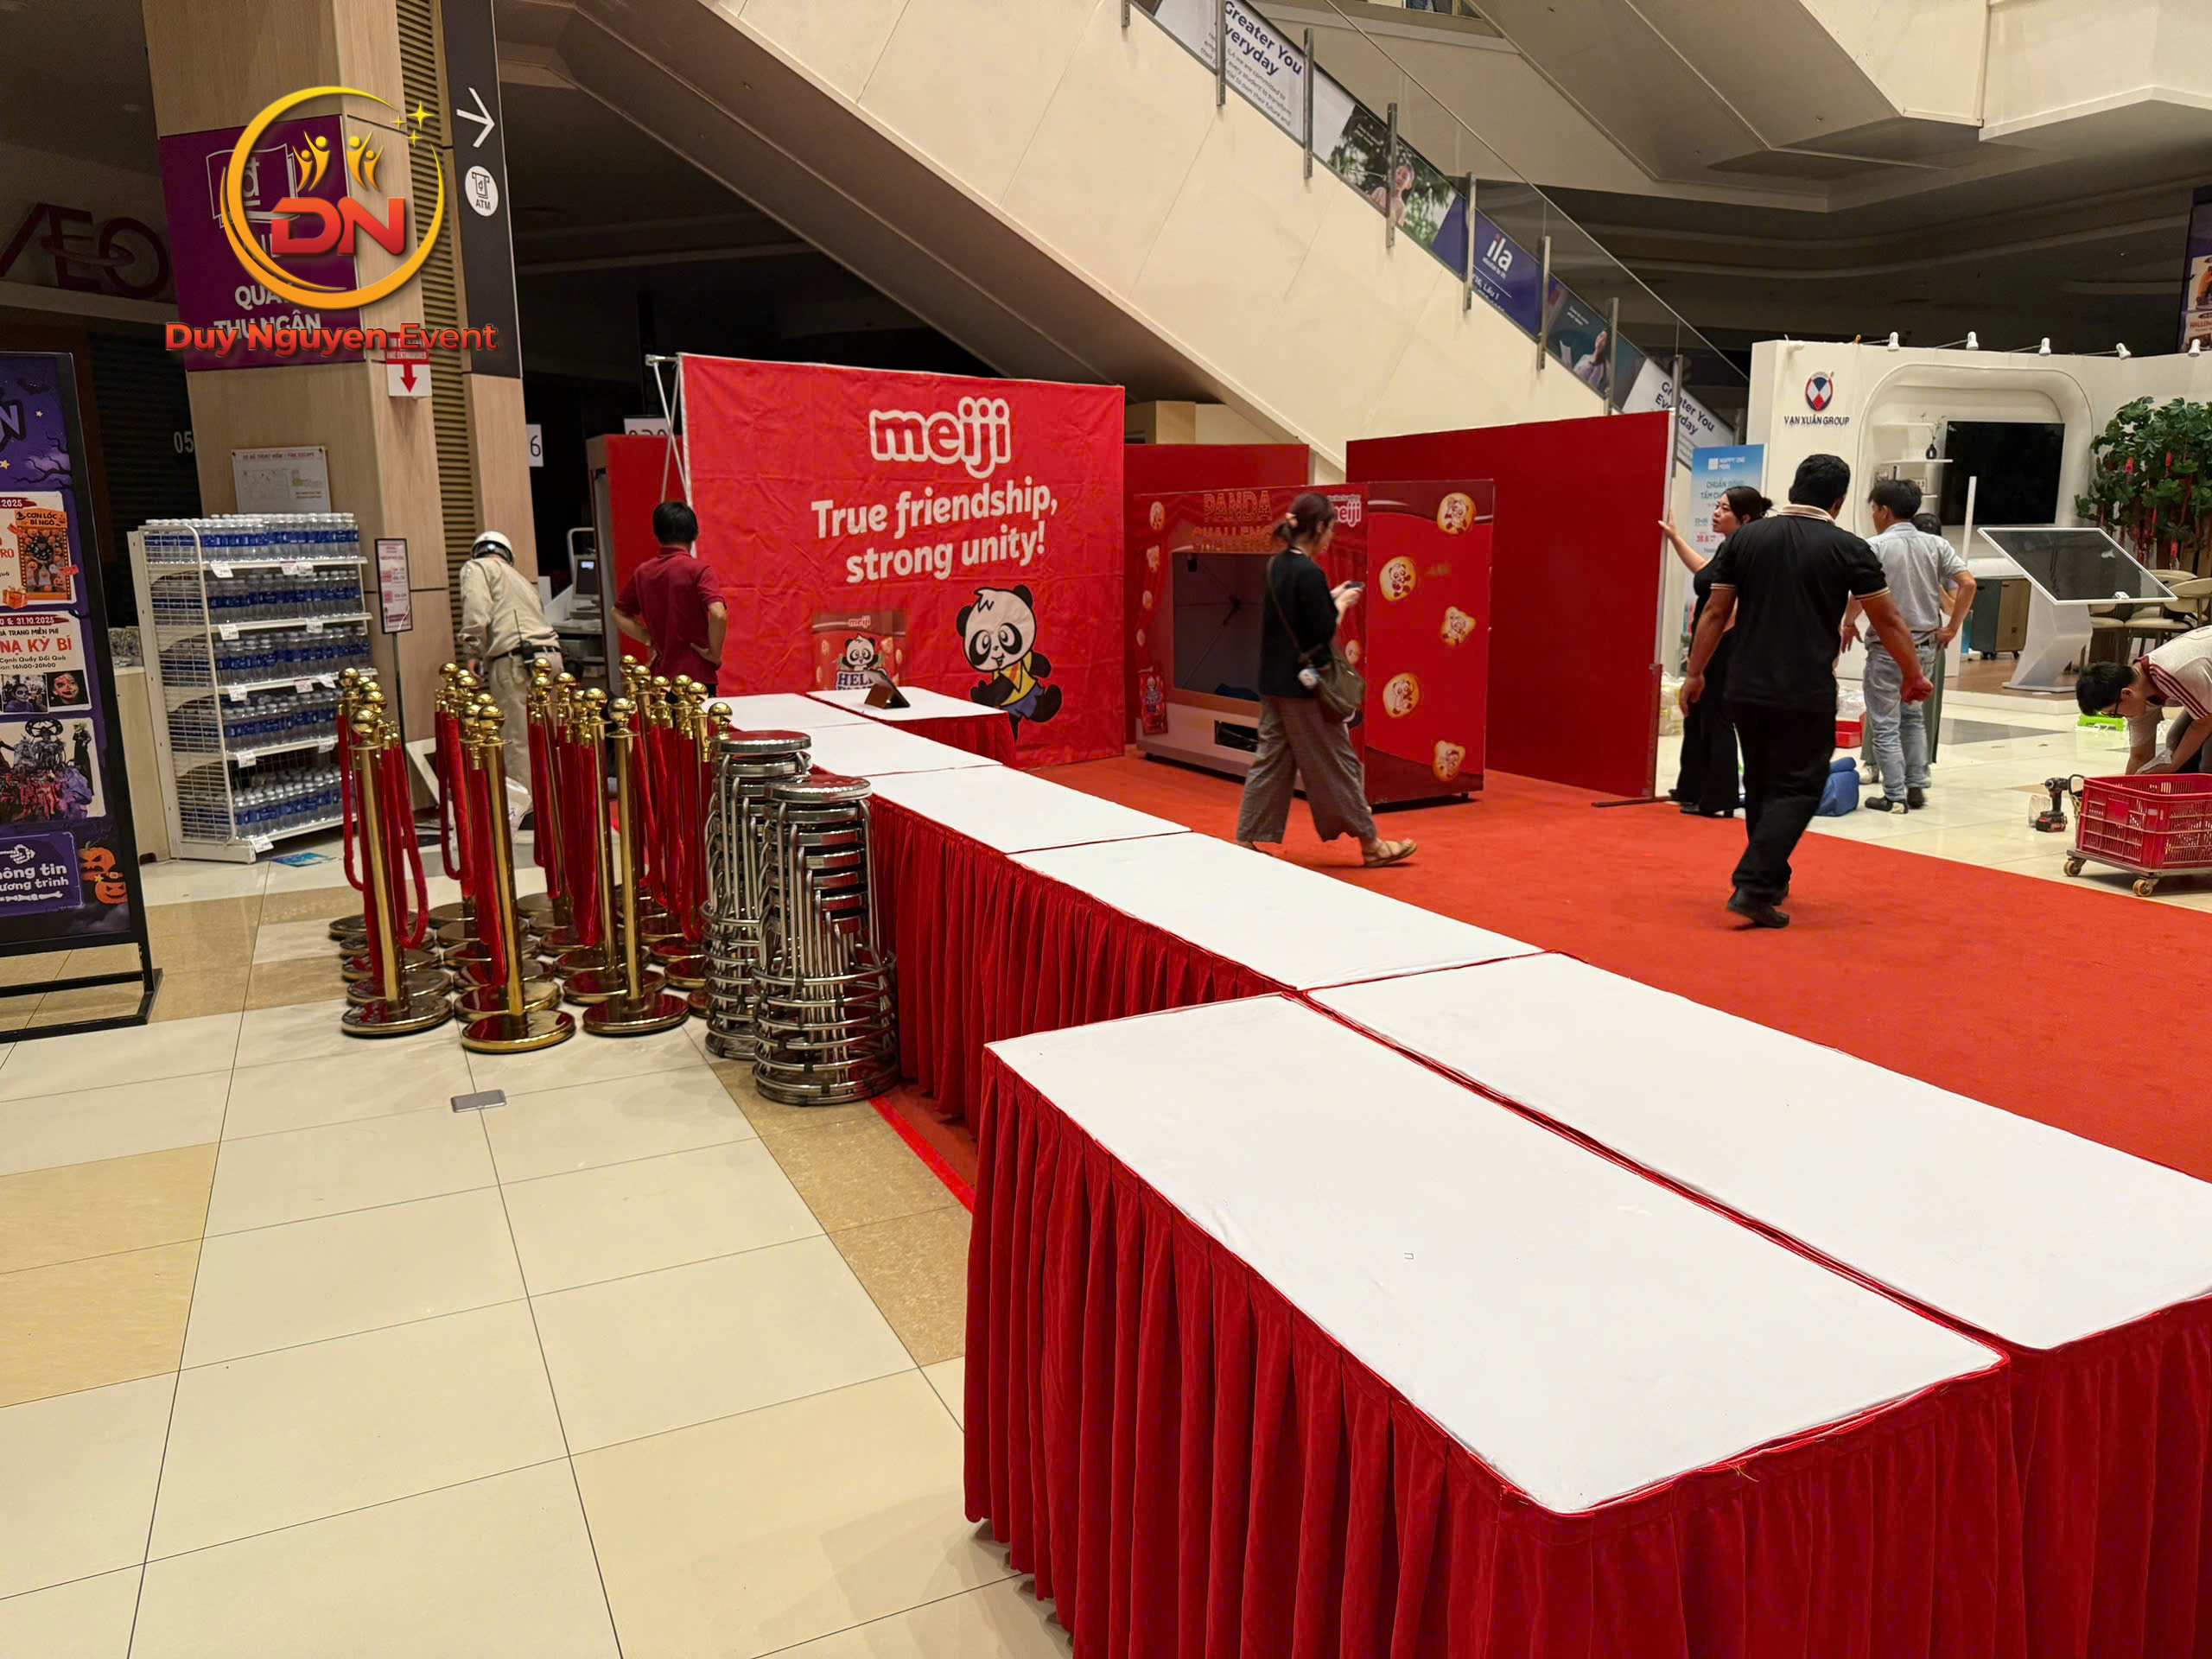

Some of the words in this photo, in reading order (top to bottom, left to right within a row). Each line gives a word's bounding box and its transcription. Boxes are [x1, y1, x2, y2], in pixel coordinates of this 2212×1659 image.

[1214, 19, 1279, 76] veryday
[1224, 1, 1274, 50] Greater
[1278, 45, 1302, 75] You
[476, 199, 492, 210] ATM
[1486, 234, 1513, 271] ila
[1662, 382, 1695, 415] Grter
[1697, 411, 1714, 431] You
[1823, 416, 1850, 425] GROUP
[868, 397, 1011, 479] meiji
[811, 499, 887, 539] True
[894, 476, 1058, 539] friendship,
[1203, 491, 1273, 521] PANDA
[846, 543, 953, 583] strong
[962, 520, 1046, 566] unity!
[849, 615, 871, 628] meiji
[28, 636, 50, 652] KỲ
[57, 635, 72, 652] BÍ
[837, 673, 876, 686] HEL
[35, 876, 69, 888] trình
[40, 863, 67, 875] tin
